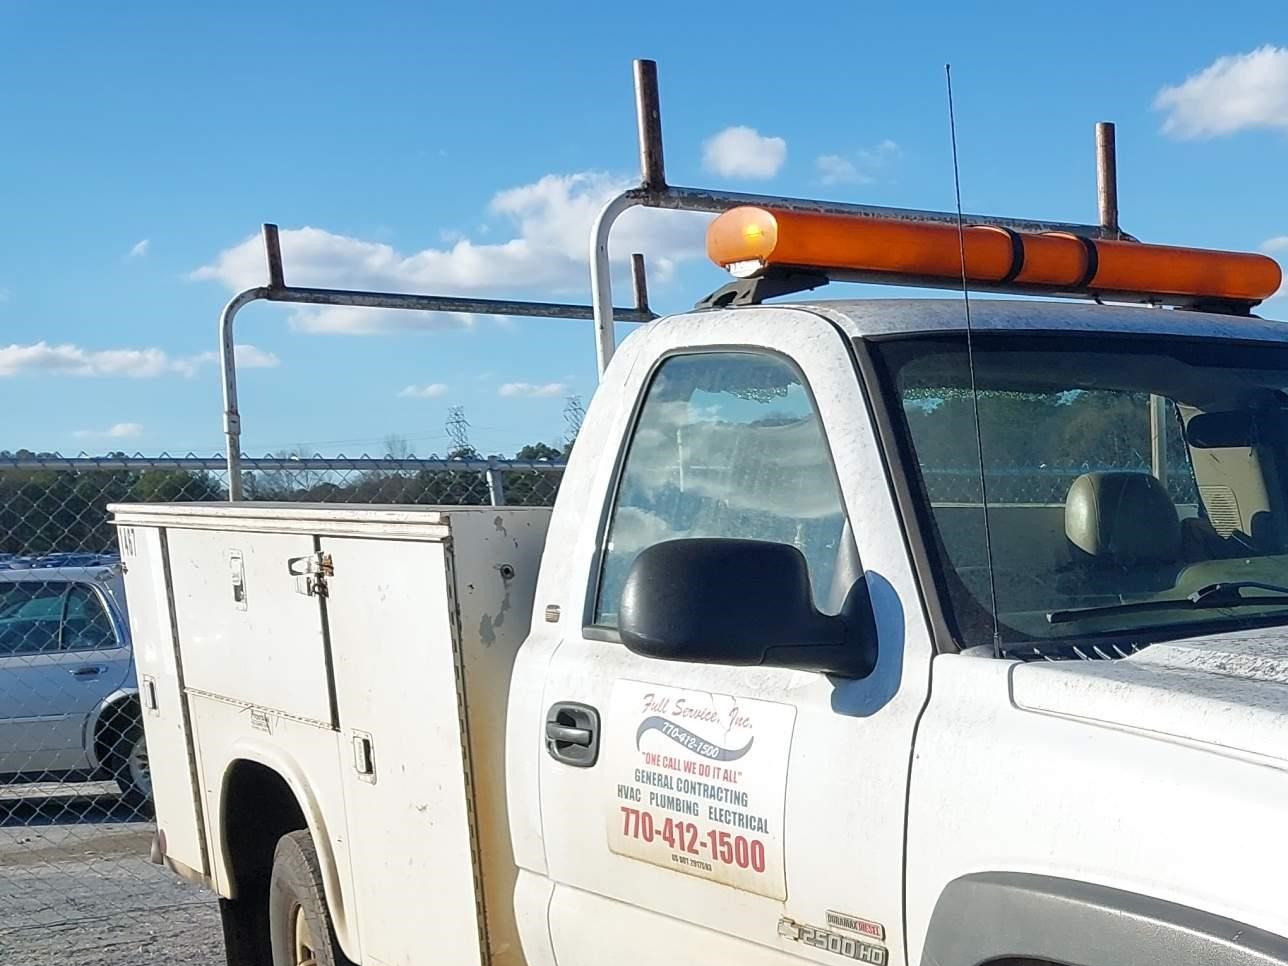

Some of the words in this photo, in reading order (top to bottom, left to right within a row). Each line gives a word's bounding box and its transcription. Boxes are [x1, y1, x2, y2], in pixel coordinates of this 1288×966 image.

[641, 693, 669, 714] Full
[728, 706, 753, 729] Inc.
[661, 722, 720, 758] 770-412-1500
[663, 756, 681, 771] CALL
[684, 760, 697, 774] WE
[699, 763, 711, 777] DO
[713, 766, 721, 779] IT
[634, 768, 674, 790] GENERAL
[676, 777, 748, 807] CONTRACTING
[617, 784, 641, 802] HVAC
[650, 792, 699, 816] PLUMBING
[709, 806, 769, 834] ELECTRICAL
[620, 806, 766, 873] 770-412-1500
[802, 927, 857, 959] 2500
[859, 943, 886, 966] HD
